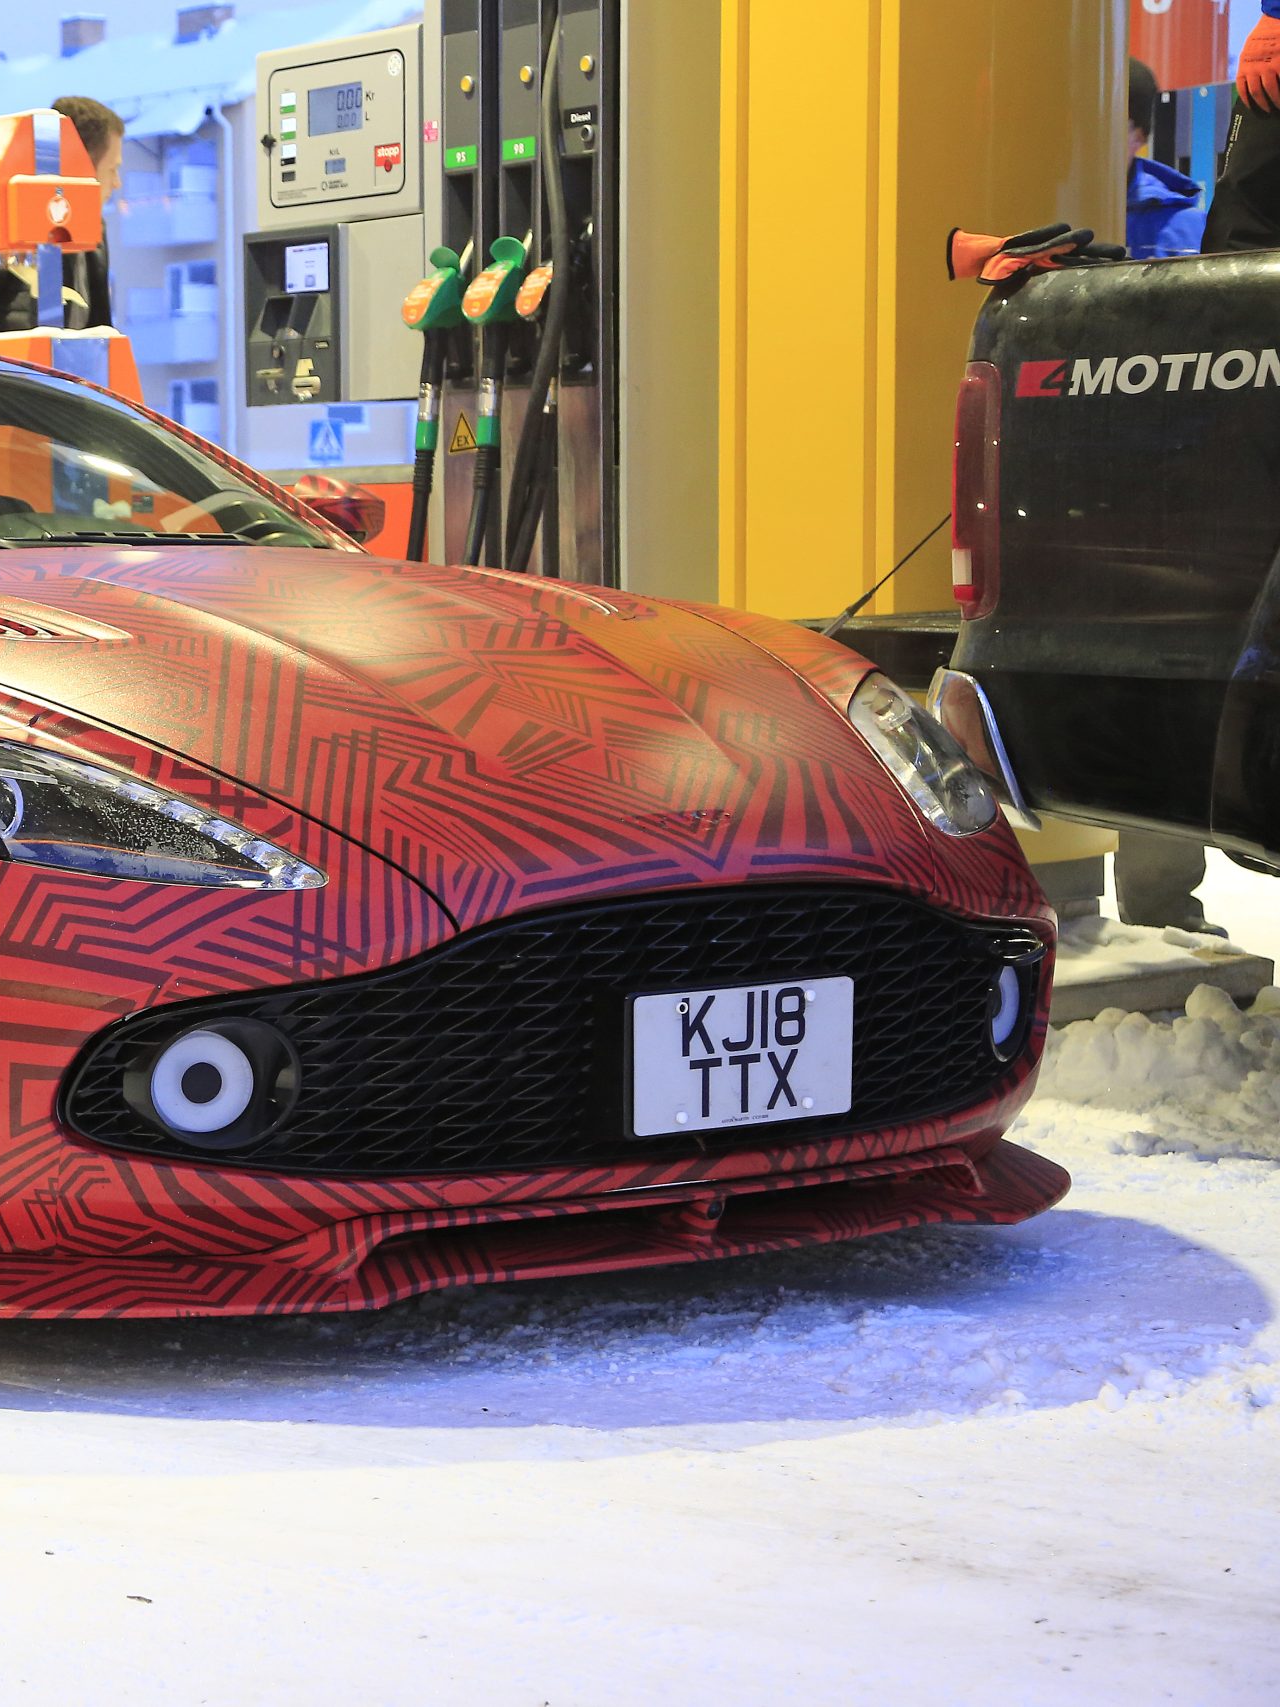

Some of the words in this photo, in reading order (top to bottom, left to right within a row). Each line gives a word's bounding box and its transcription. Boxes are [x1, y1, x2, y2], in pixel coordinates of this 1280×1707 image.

[570, 111, 592, 124] Diesel
[377, 146, 400, 158] stopp
[513, 143, 524, 155] 98
[455, 151, 466, 163] 95
[457, 435, 470, 447] EX
[681, 986, 806, 1057] KJ18
[689, 1049, 799, 1118] TTX
